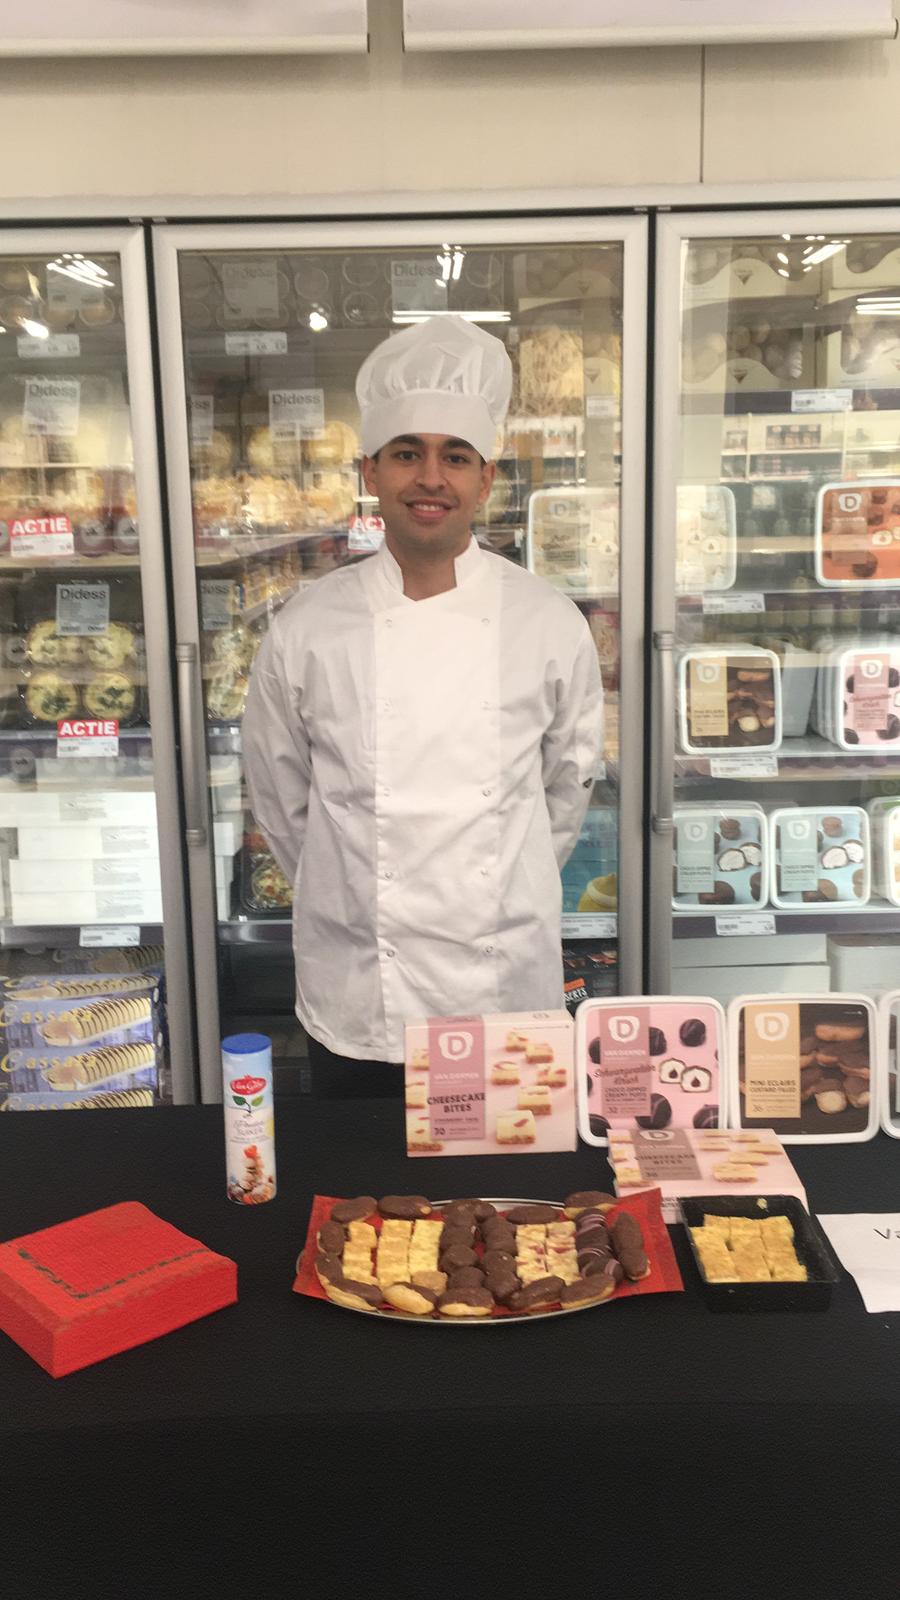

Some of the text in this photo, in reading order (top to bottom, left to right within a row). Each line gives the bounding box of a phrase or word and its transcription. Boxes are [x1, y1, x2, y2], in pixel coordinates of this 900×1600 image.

[28, 384, 78, 398] Didess
[272, 393, 321, 405] Didess
[12, 517, 69, 535] ACTIE
[60, 588, 107, 600] Didess
[60, 721, 116, 736] ACTIE
[427, 1092, 486, 1105] CHEESECAKE
[443, 1103, 472, 1113] BITES
